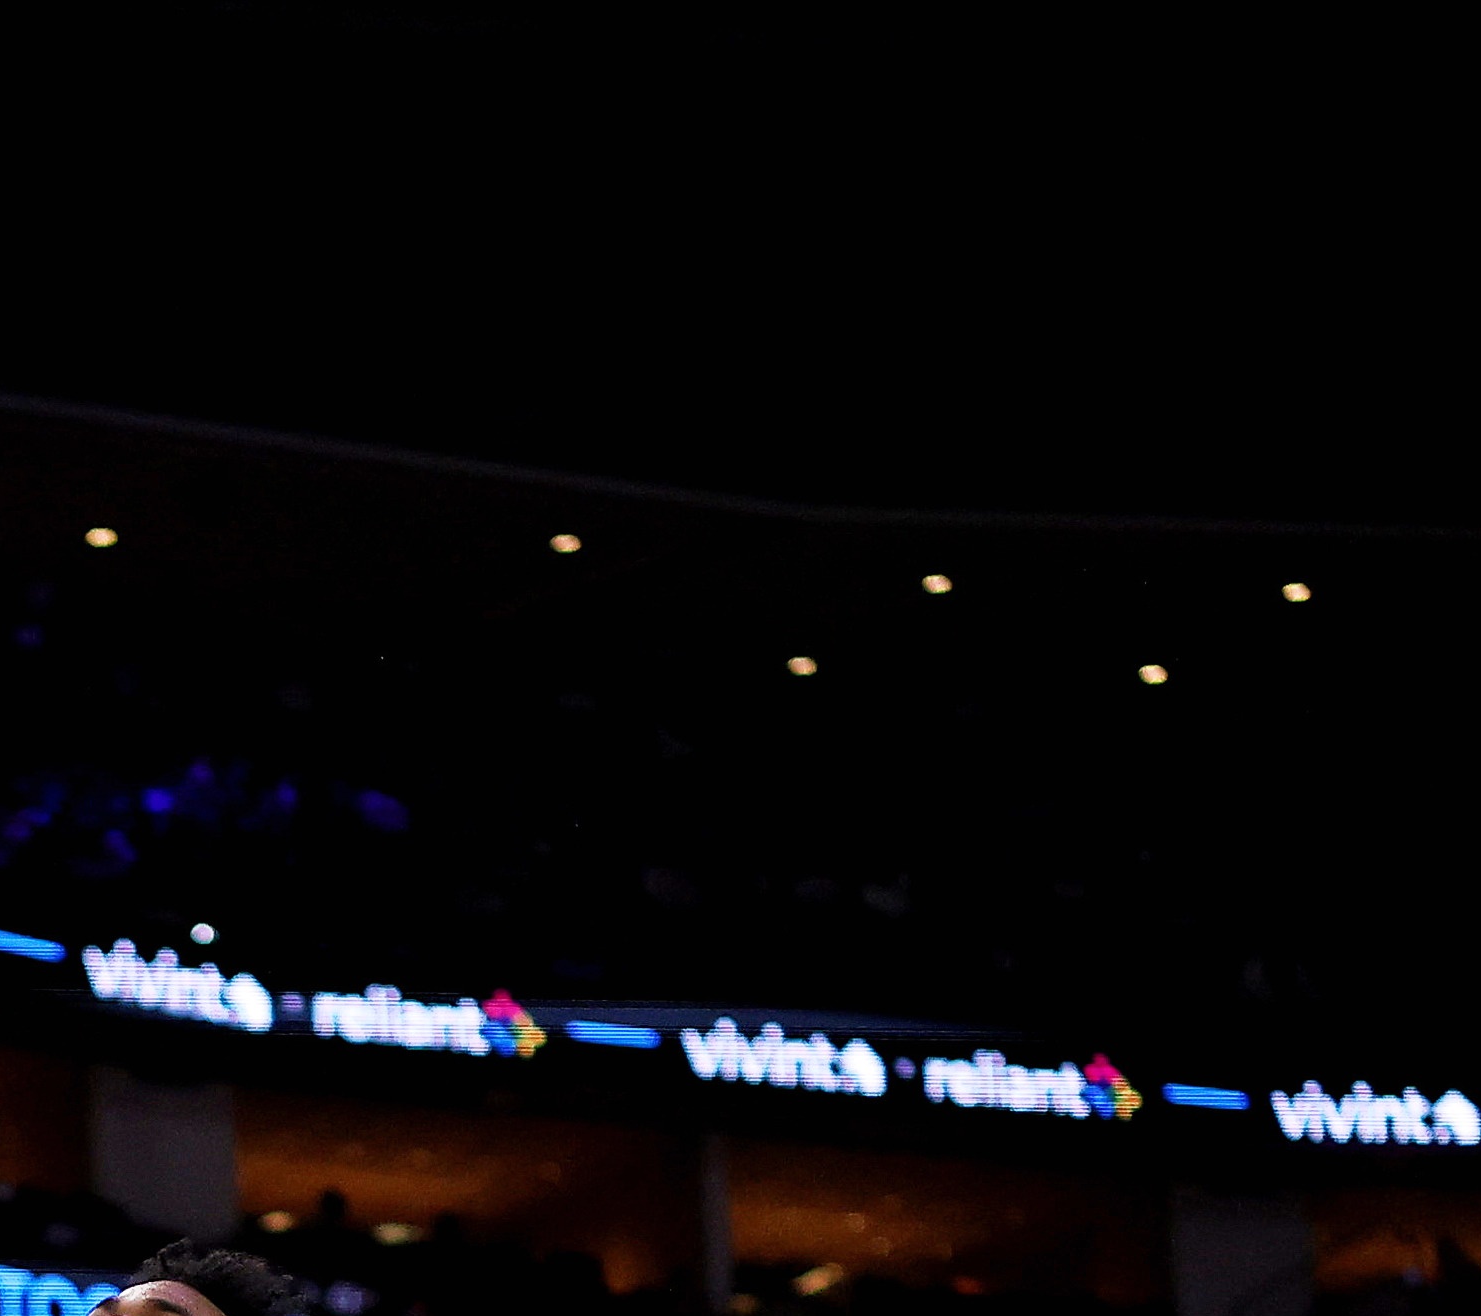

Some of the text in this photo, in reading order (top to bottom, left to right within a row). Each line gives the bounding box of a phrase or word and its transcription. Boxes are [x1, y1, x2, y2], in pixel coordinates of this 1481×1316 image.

[83, 938, 222, 1021] vivint
[312, 986, 491, 1056] reliant
[680, 1017, 841, 1092] vivint
[924, 1051, 1092, 1118] reliant
[1271, 1080, 1425, 1144] vivint
